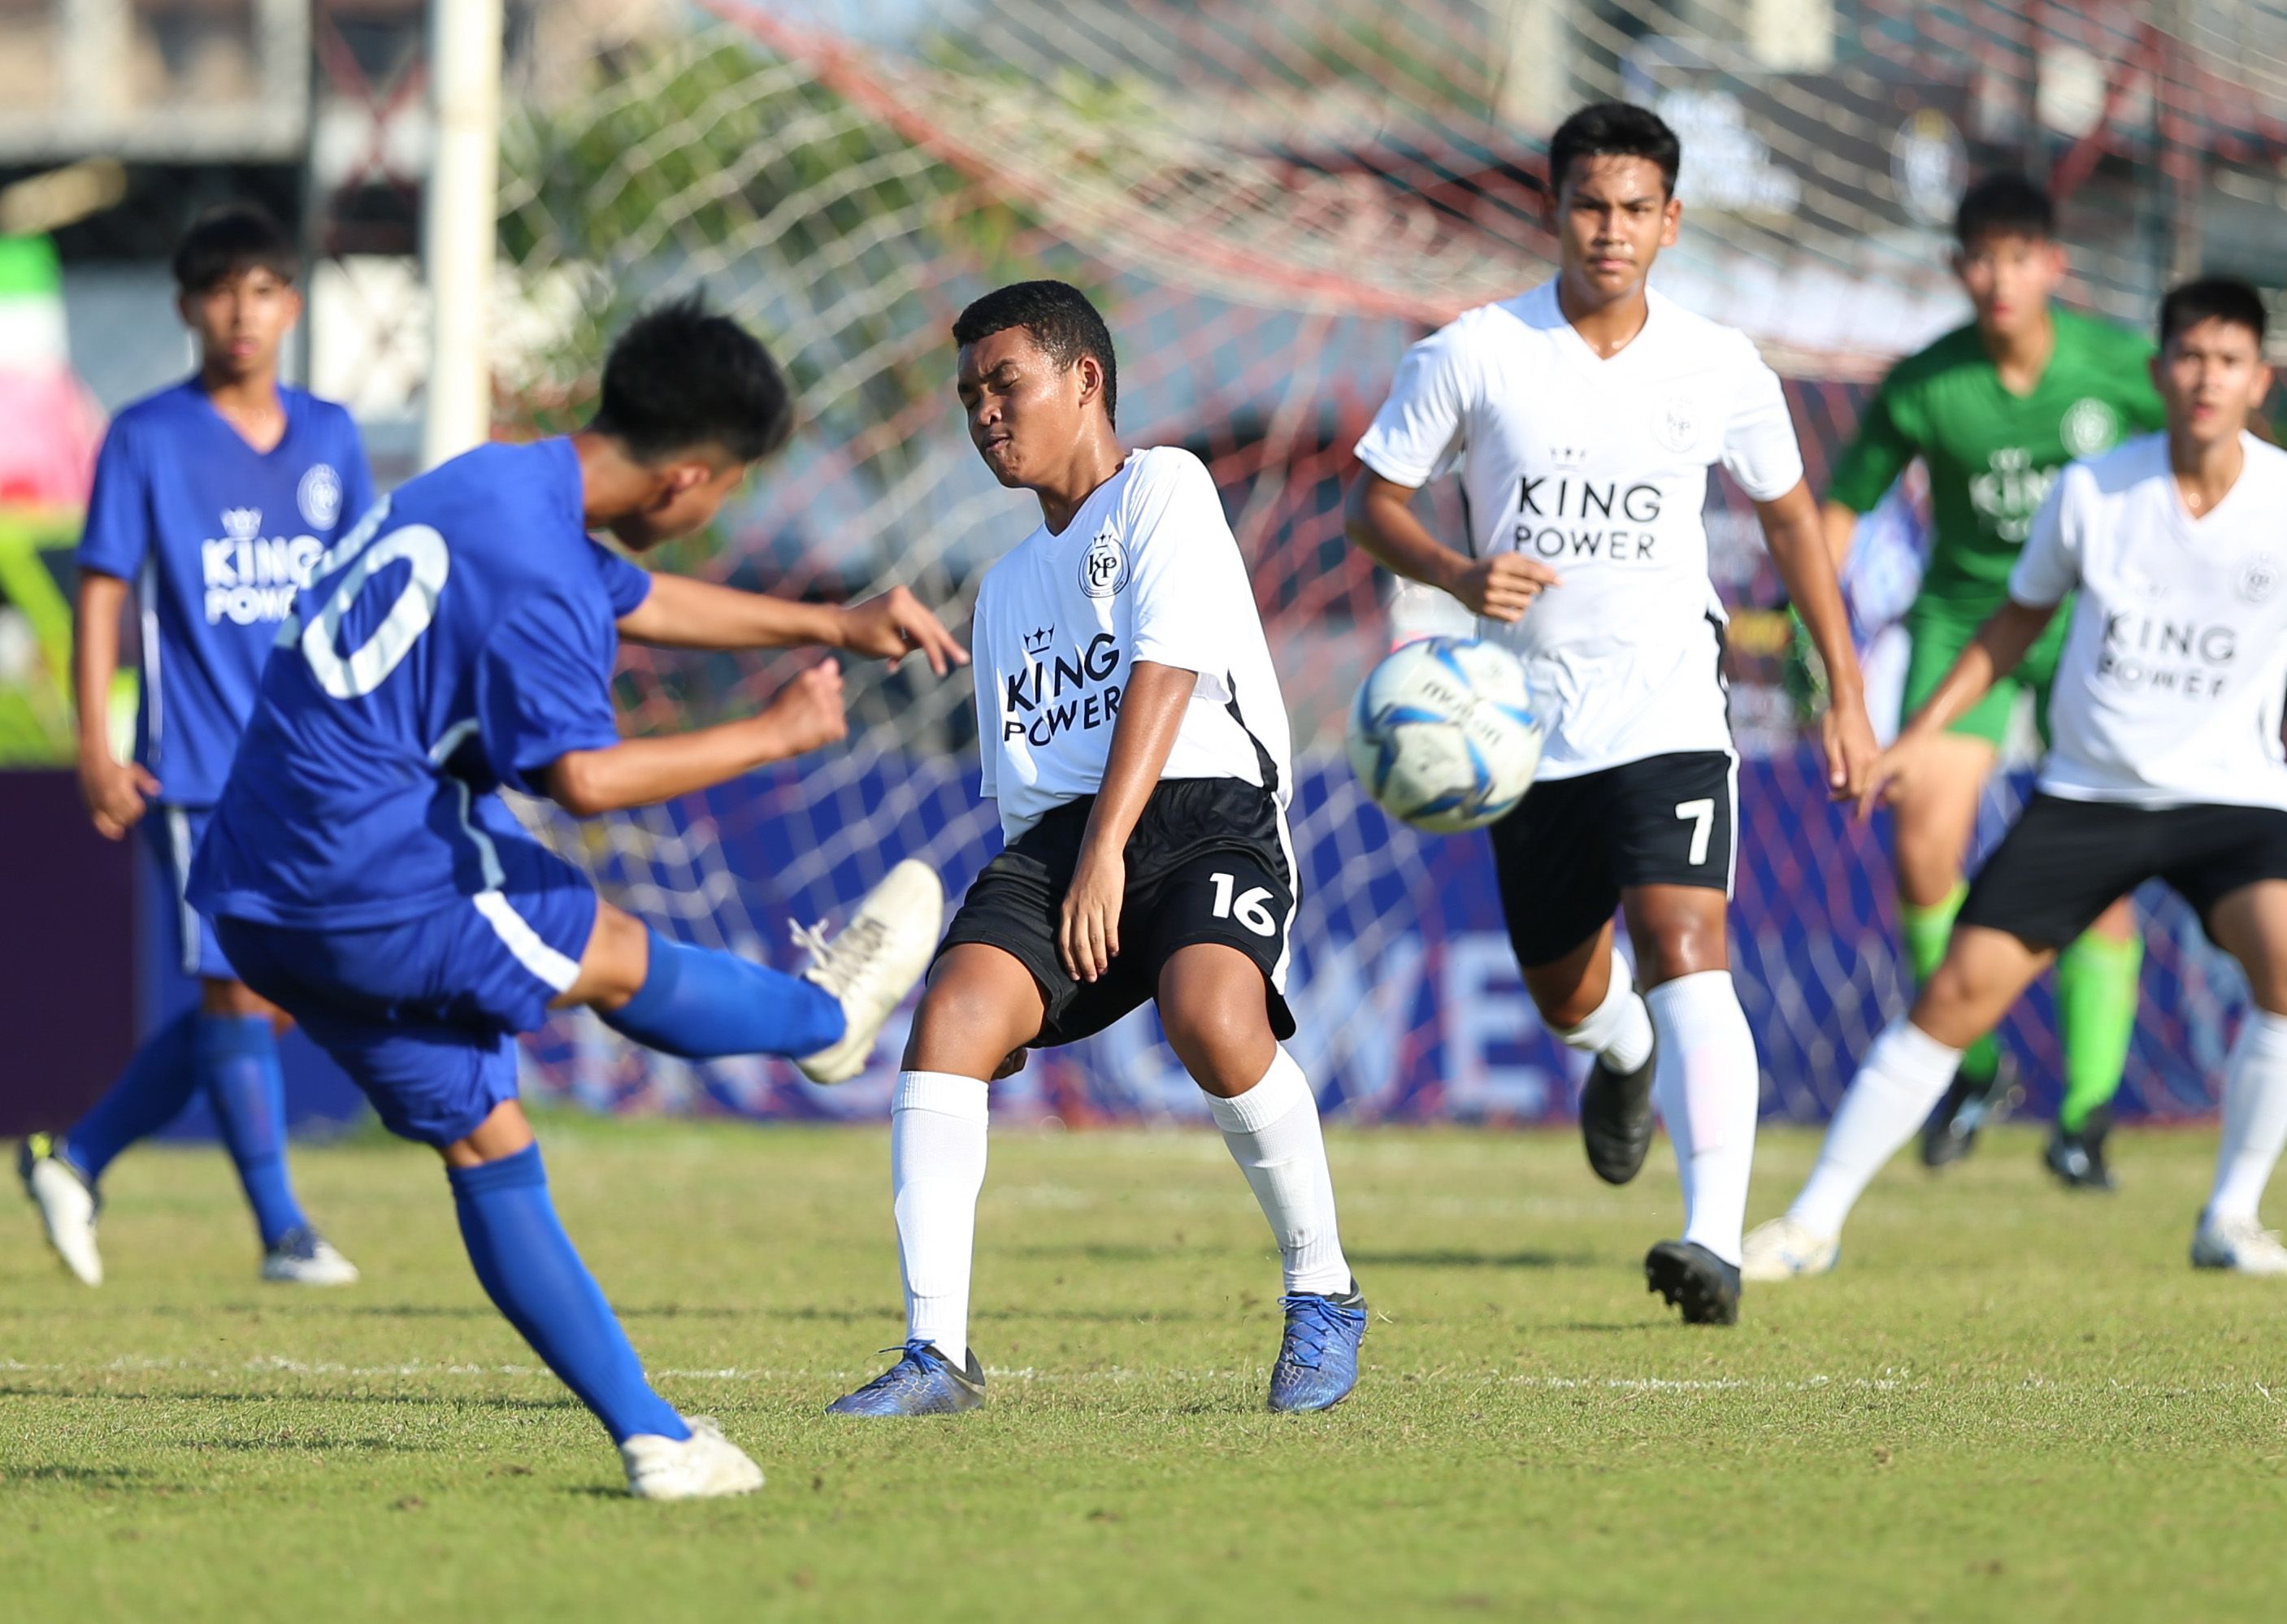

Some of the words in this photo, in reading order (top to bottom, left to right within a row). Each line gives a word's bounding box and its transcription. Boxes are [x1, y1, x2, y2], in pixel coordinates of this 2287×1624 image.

[1518, 474, 1663, 523] KING
[1968, 464, 2059, 519] KIN
[200, 534, 325, 589] KING
[1513, 524, 1656, 560] POWER
[2100, 610, 2238, 667] KING
[1006, 632, 1120, 713] KING
[1003, 685, 1122, 747] POWER
[1675, 798, 1715, 866] 7
[1209, 872, 1277, 937] 16
